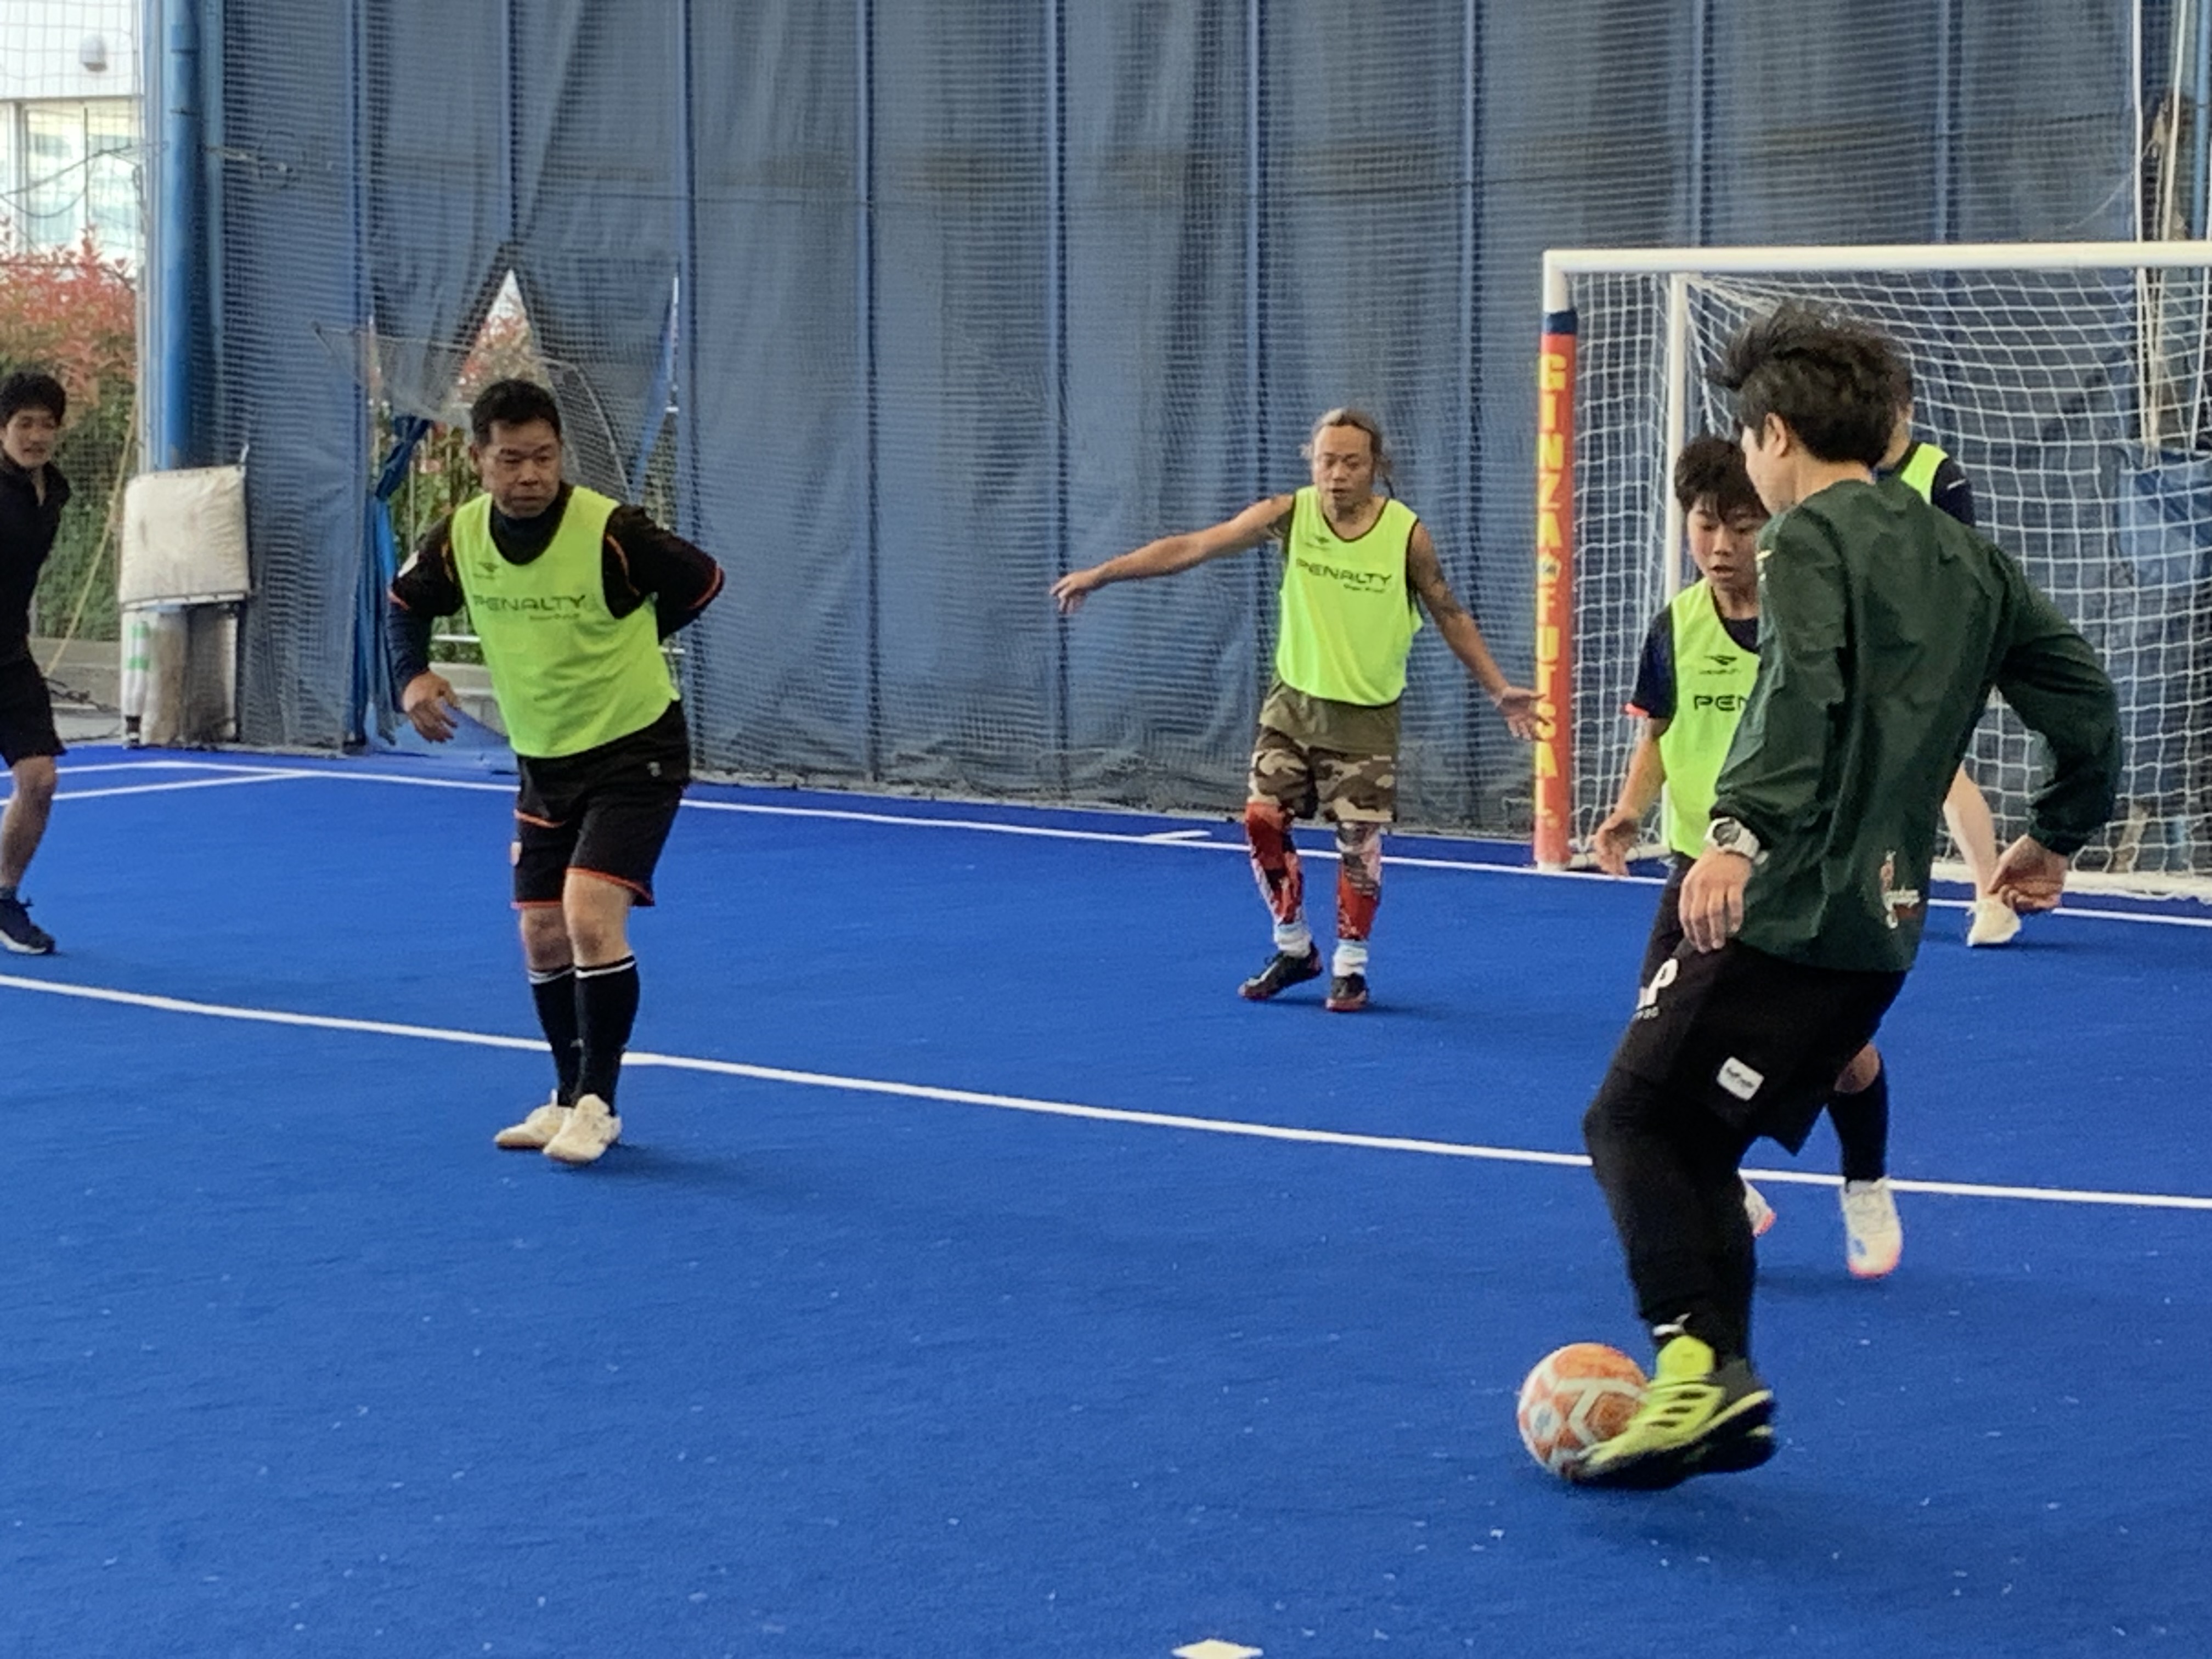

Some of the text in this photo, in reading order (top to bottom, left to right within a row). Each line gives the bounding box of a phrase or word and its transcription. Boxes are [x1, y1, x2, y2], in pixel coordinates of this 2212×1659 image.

[1538, 354, 1567, 549] GINZA
[1296, 557, 1392, 586] PENALTY
[473, 594, 586, 611] PENALTY
